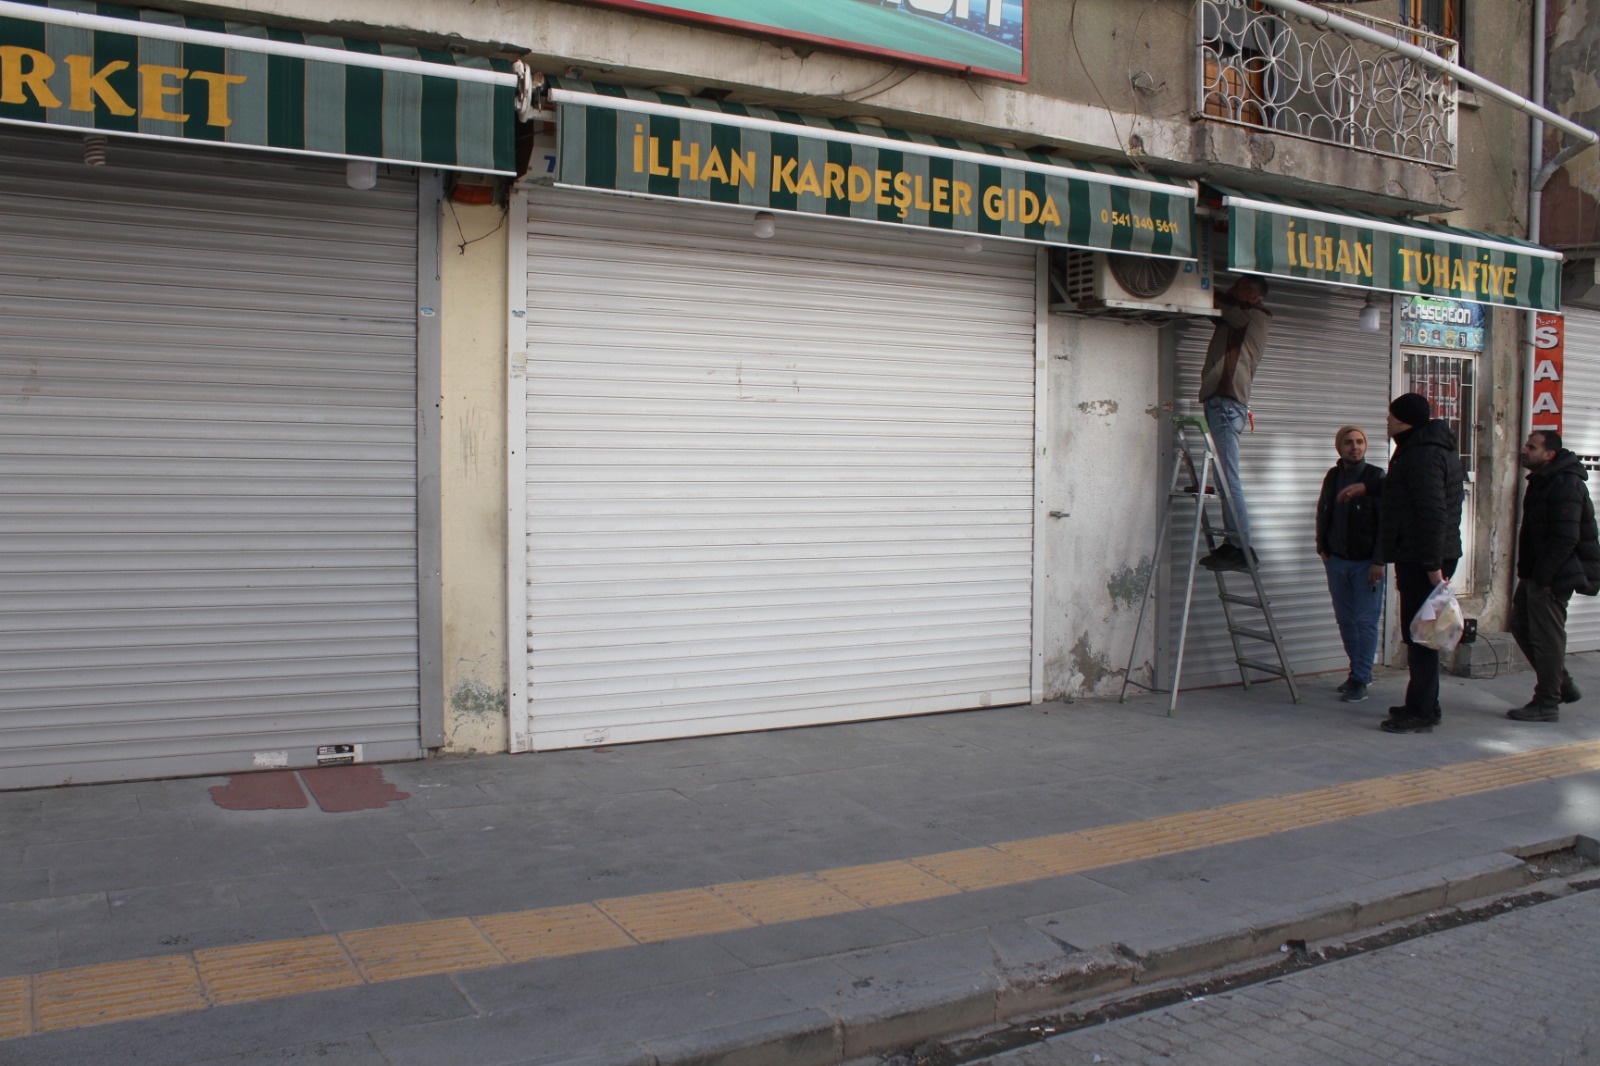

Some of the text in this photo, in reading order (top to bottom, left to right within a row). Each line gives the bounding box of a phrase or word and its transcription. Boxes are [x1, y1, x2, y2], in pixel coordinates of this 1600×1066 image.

[633, 123, 757, 189] İLHAN
[771, 154, 973, 219] KARDEŞLER
[983, 185, 1062, 227] GIDA
[1101, 209, 1109, 224] 0
[1112, 210, 1131, 227] 541
[1156, 219, 1179, 234] 5611
[1287, 220, 1518, 298] İLHAN TUHAFİYE
